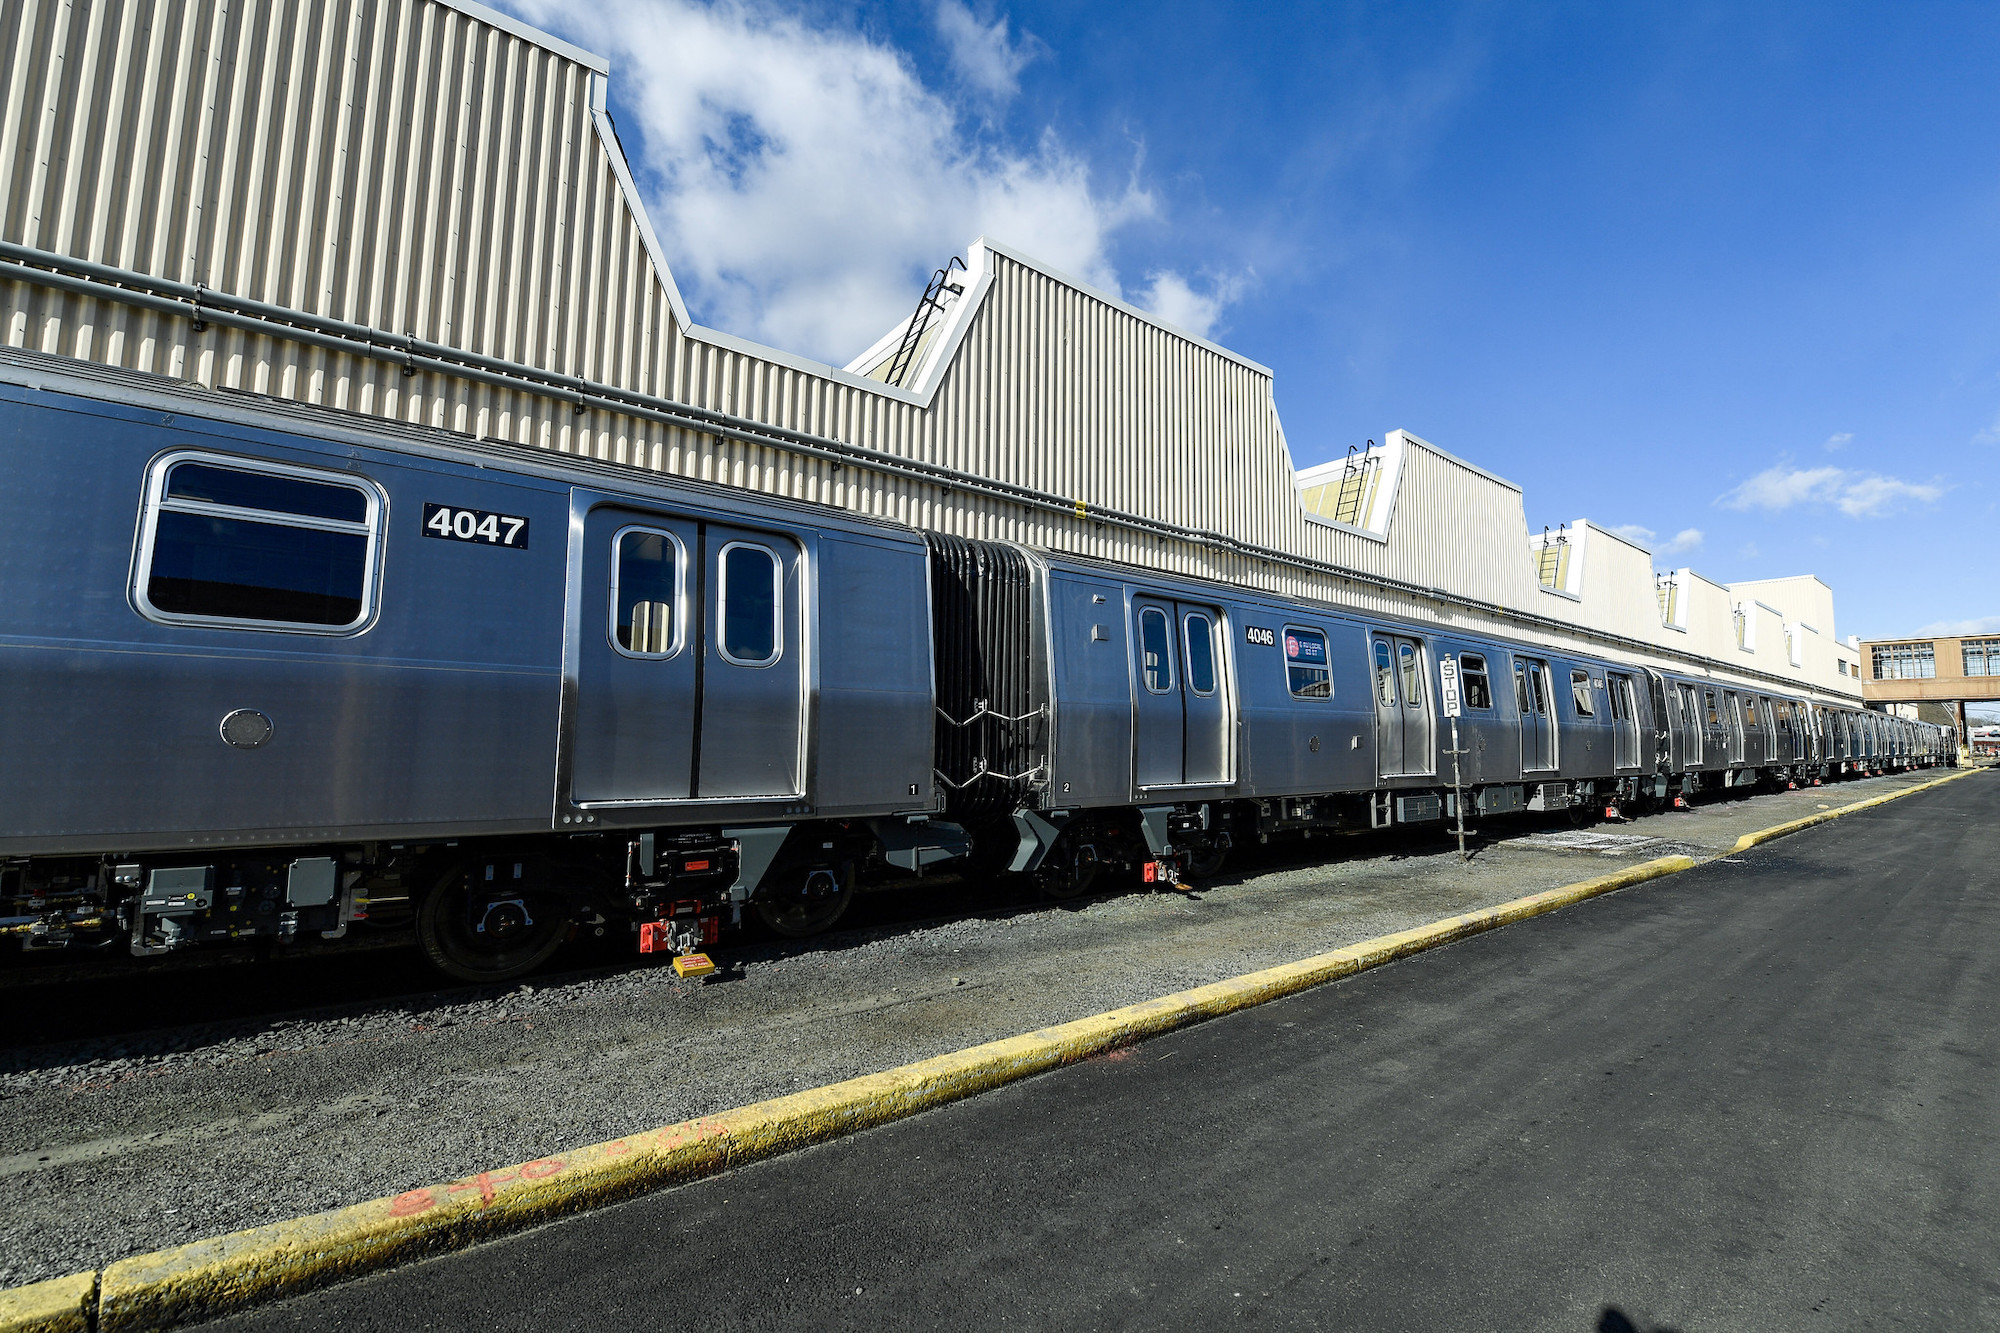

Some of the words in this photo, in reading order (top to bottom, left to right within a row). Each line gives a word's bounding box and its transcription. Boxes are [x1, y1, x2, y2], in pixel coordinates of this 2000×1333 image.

[428, 507, 525, 545] 4047
[1247, 627, 1274, 646] 4046
[1443, 664, 1458, 714] STOP
[910, 784, 916, 795] 1
[1063, 782, 1070, 793] 2
